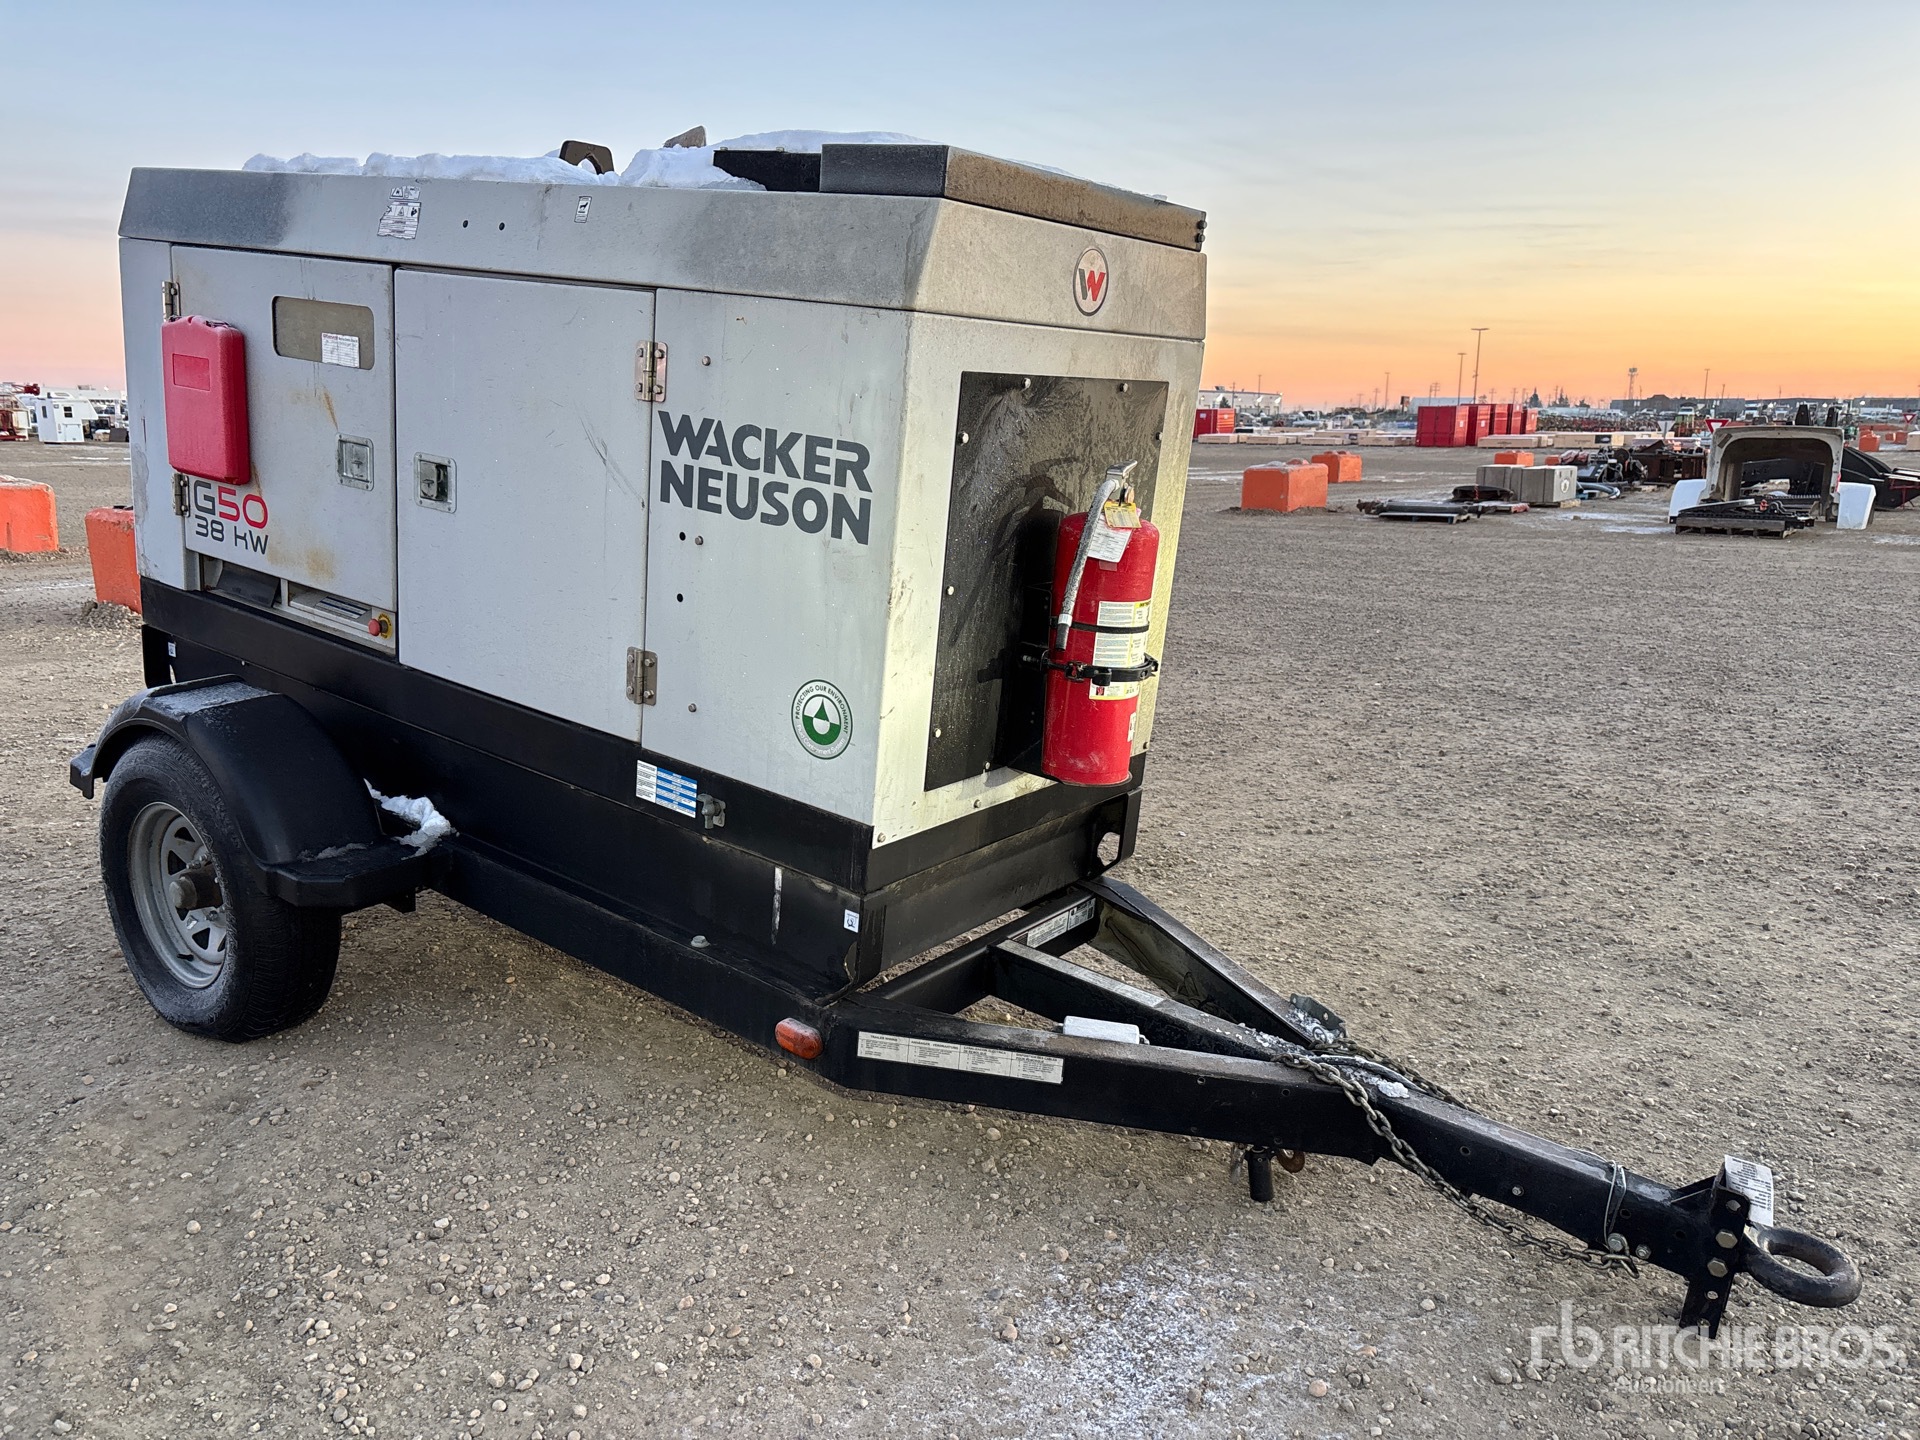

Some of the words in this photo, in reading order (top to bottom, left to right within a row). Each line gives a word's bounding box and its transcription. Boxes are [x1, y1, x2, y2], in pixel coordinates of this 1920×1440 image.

[657, 410, 873, 493] WACKER
[193, 479, 269, 530] G50
[660, 459, 872, 546] NEUSON
[194, 514, 225, 543] 38
[795, 686, 814, 719] PROTECTING
[814, 684, 826, 692] OUR
[827, 688, 849, 734] ENVIRONMENT
